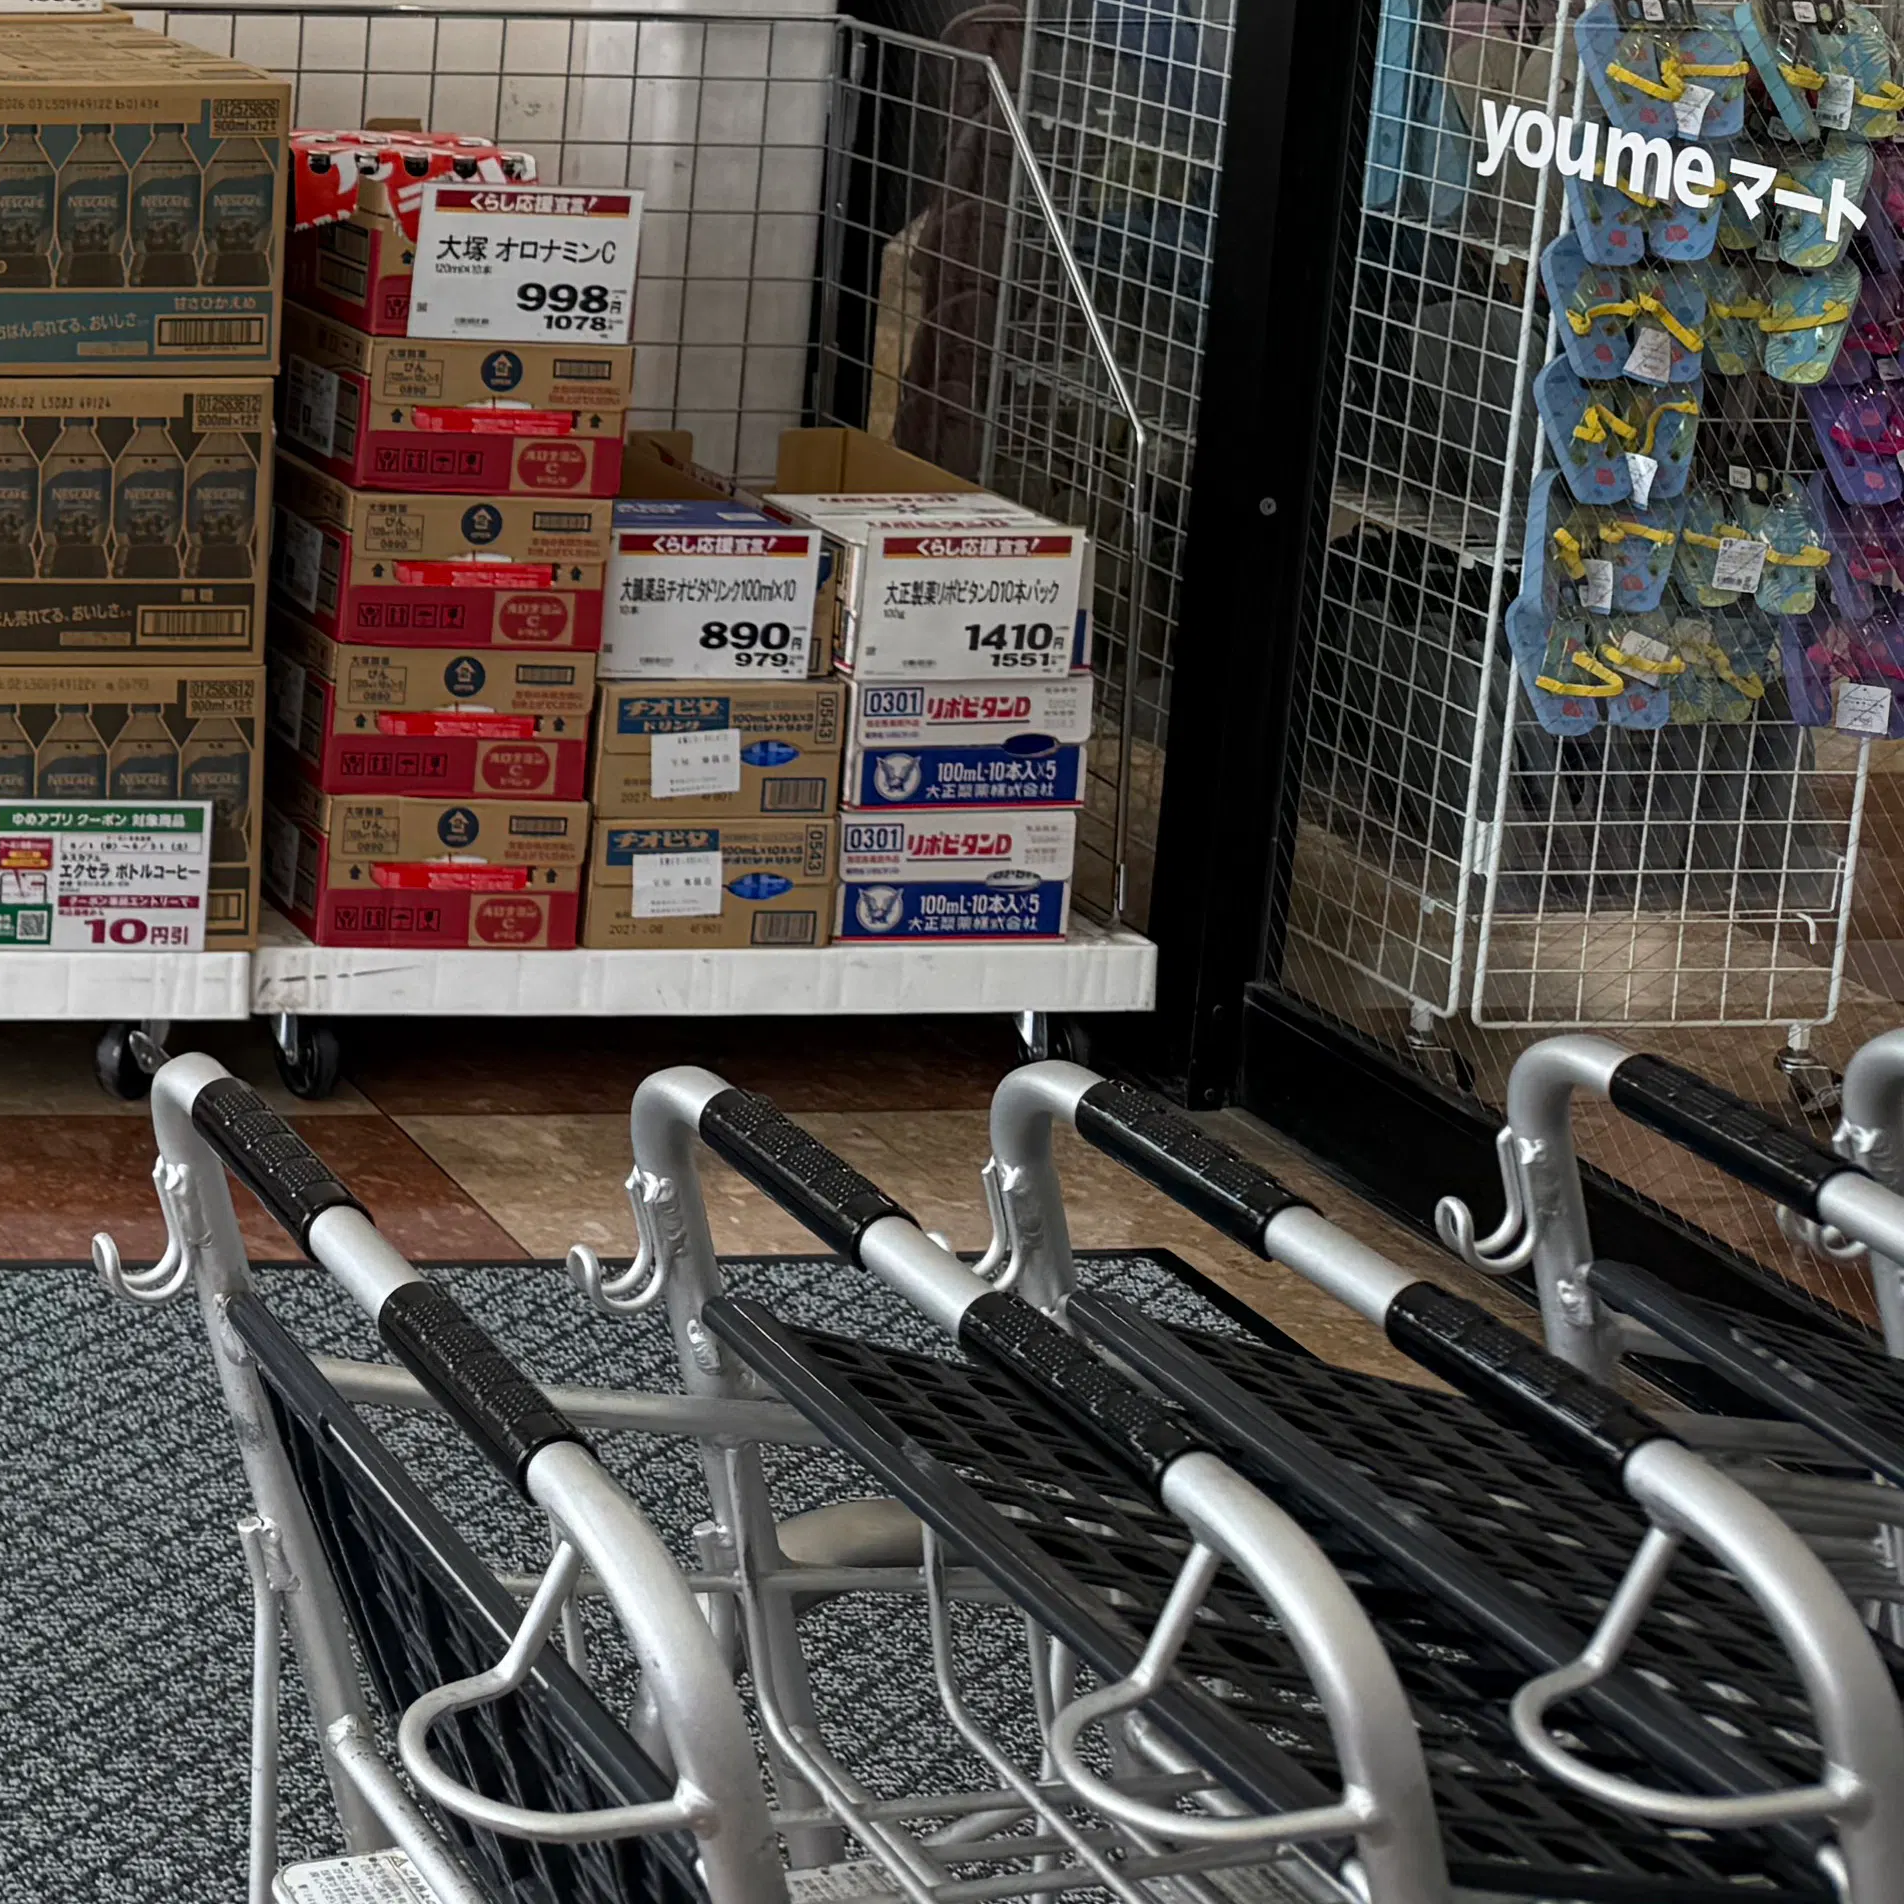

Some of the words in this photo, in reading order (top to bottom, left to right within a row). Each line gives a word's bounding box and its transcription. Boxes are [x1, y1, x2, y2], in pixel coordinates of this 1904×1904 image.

[436, 235, 488, 262] 大塚
[495, 236, 617, 265] オロナミンC
[543, 314, 607, 332] 1078
[734, 652, 788, 668] 979
[990, 653, 1050, 667] 1551
[870, 689, 918, 713] 0301
[927, 694, 1031, 719] リポビタンD
[851, 827, 897, 851] 0301
[908, 832, 1013, 856] リポビタンD
[59, 863, 111, 879] エクセラ
[115, 863, 201, 879] ボトルコーヒー
